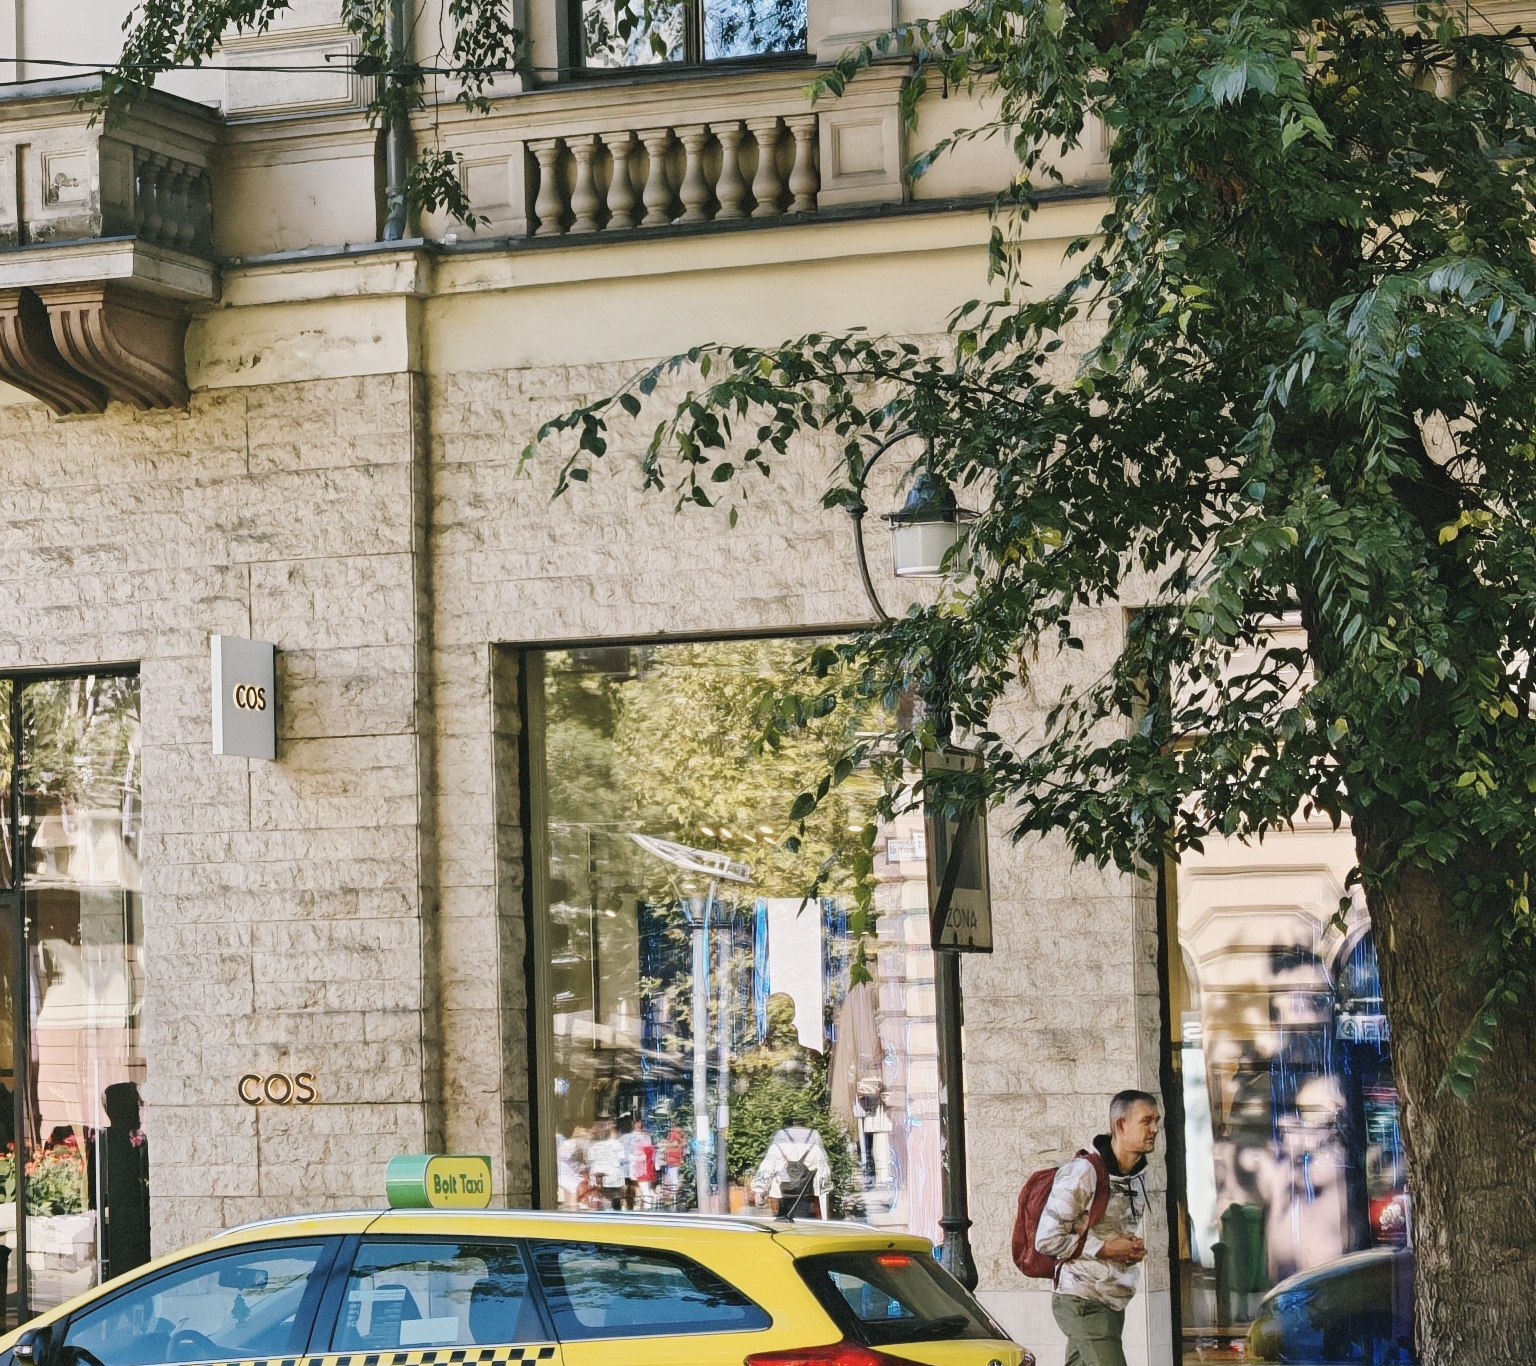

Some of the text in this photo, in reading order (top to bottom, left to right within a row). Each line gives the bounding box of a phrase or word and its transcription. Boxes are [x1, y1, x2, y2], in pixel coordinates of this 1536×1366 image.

[234, 684, 267, 711] COS
[237, 1072, 318, 1105] COS
[433, 1172, 484, 1201] Bolt Taxi
